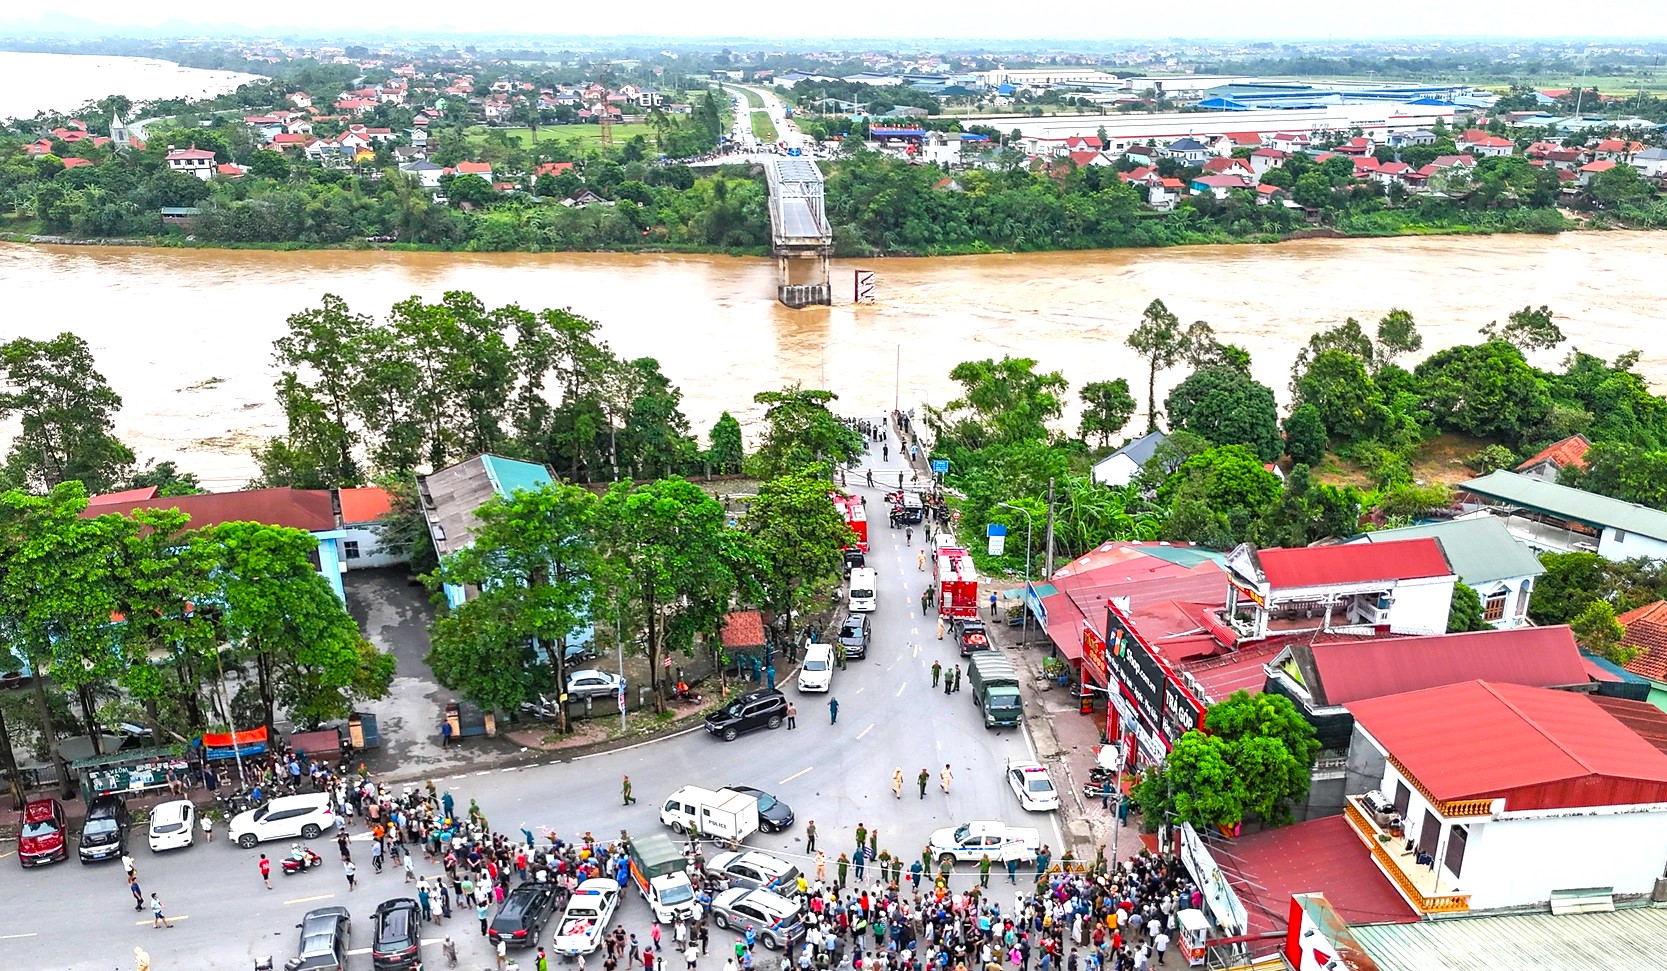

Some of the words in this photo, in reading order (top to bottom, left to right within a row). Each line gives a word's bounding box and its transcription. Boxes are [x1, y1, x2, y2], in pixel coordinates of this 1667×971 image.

[1165, 689, 1178, 714] TRẢ
[1178, 708, 1193, 730] GÓP
[708, 819, 727, 829] POLICE
